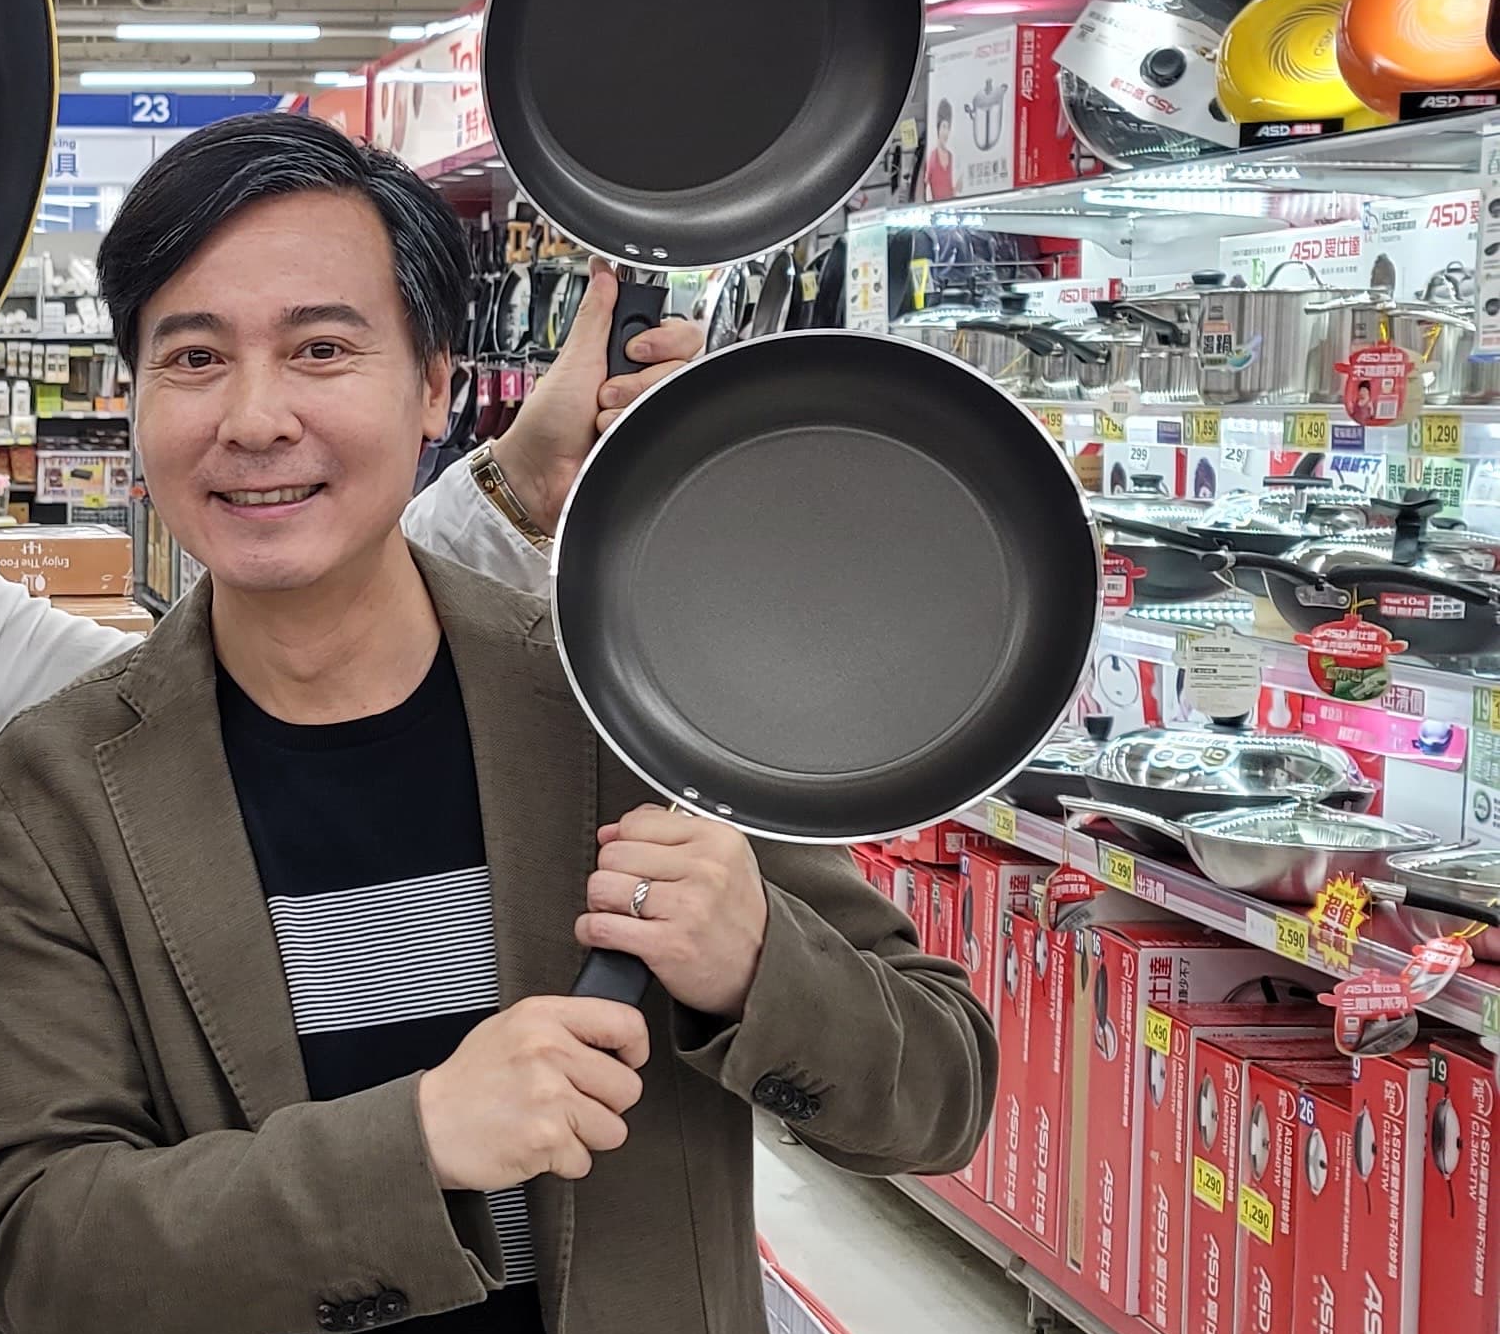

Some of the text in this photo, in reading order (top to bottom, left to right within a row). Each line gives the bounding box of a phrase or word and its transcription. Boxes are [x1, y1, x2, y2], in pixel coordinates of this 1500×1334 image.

[132, 96, 172, 122] 23
[1421, 96, 1460, 108] ASD
[1256, 125, 1291, 137] ASD
[1425, 202, 1467, 229] ASD
[1290, 241, 1323, 260] ASD
[1059, 290, 1080, 303] ASD
[1299, 420, 1326, 439] 1,490
[1426, 424, 1458, 444] 1,290
[1130, 448, 1148, 460] 299
[22, 557, 40, 568] The
[42, 557, 69, 568] Enjoy
[1323, 893, 1357, 925] 超值
[1278, 925, 1305, 950] 2,590
[1147, 1020, 1168, 1043] 1,490
[1430, 1056, 1447, 1081] 19
[1299, 1098, 1314, 1125] 26
[1039, 1106, 1050, 1167] ASD
[1102, 1160, 1114, 1225] ASD
[1198, 1169, 1221, 1195] 1,290
[1157, 1185, 1169, 1253] ASD
[1244, 1199, 1269, 1229] 1,290
[1208, 1233, 1220, 1297] ASD
[1258, 1266, 1272, 1332] ASD
